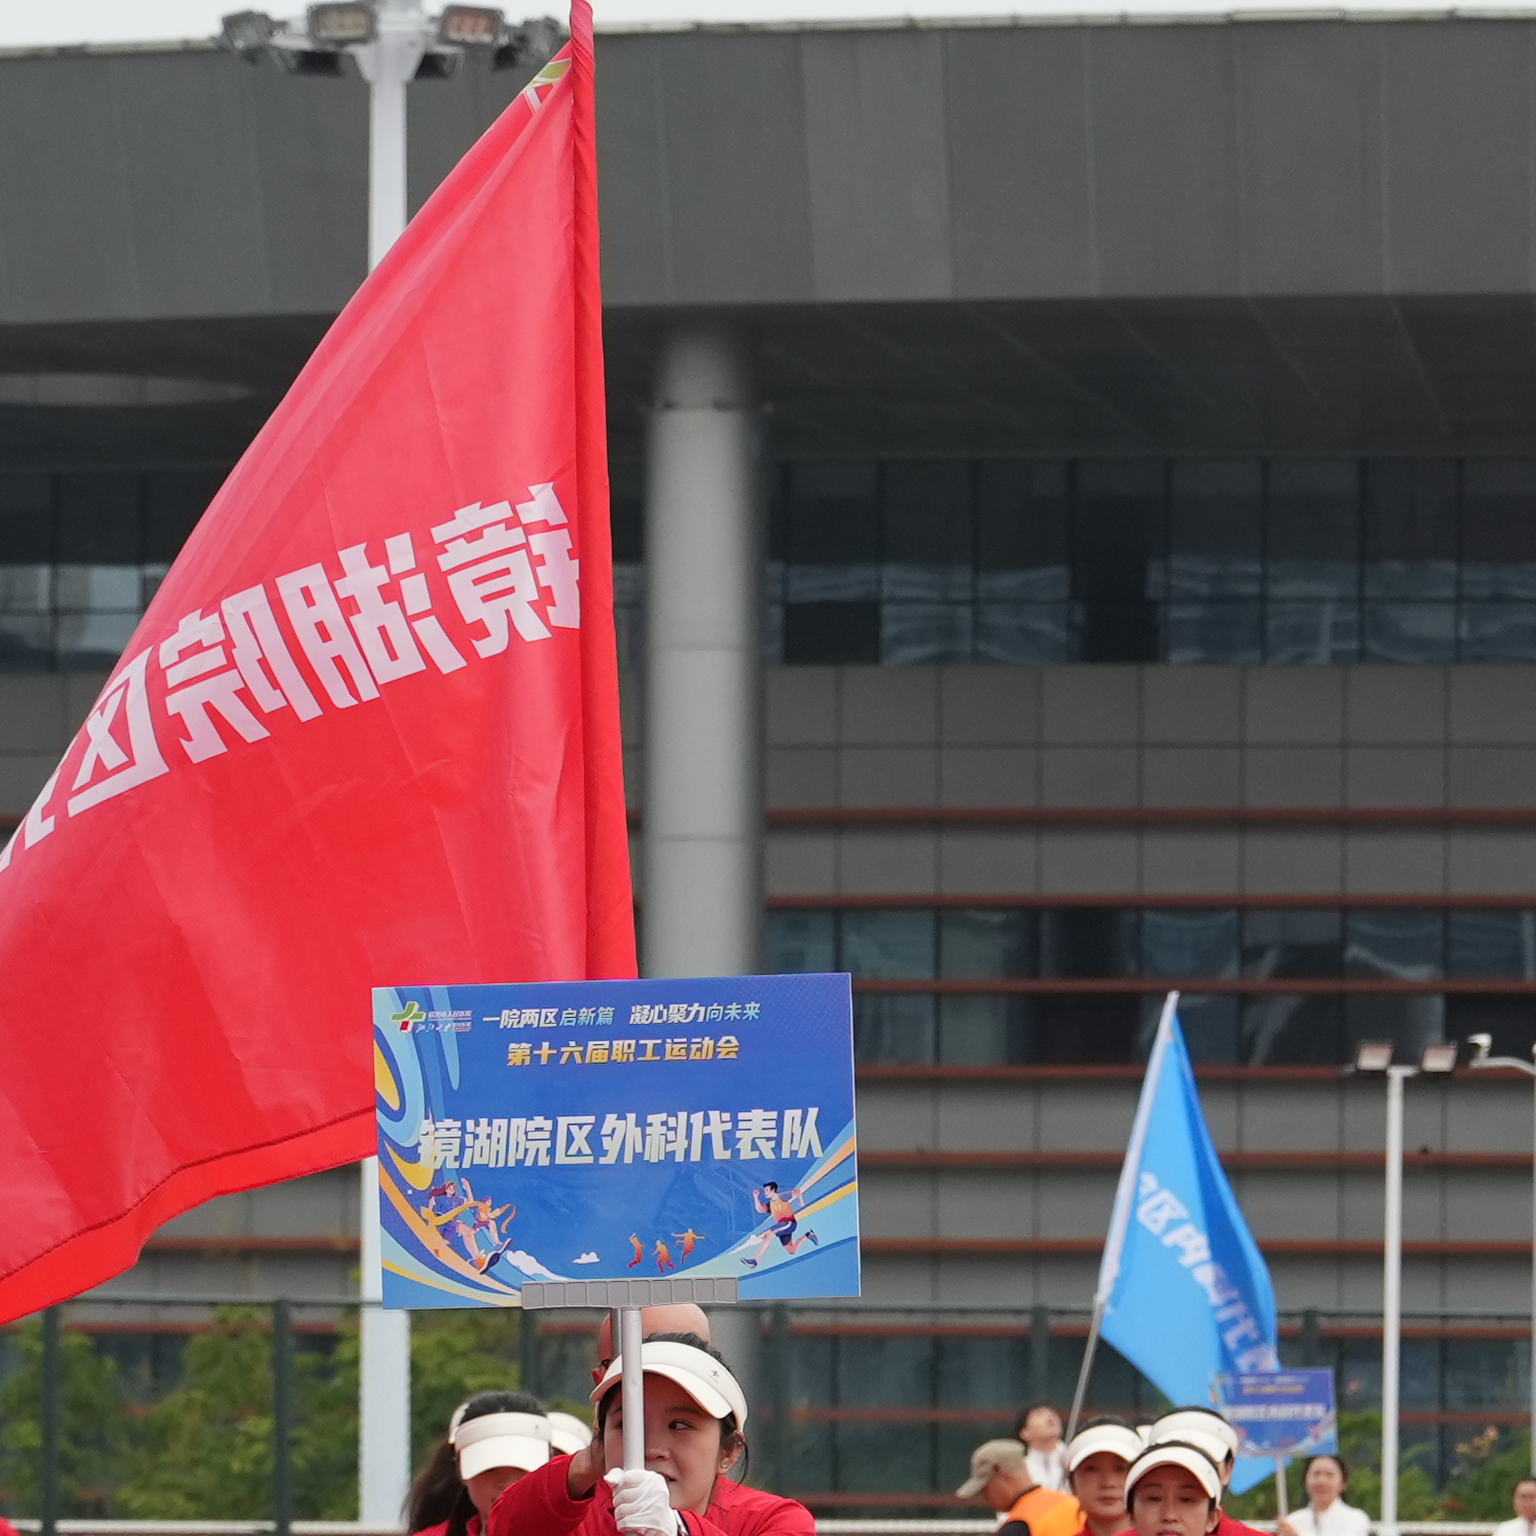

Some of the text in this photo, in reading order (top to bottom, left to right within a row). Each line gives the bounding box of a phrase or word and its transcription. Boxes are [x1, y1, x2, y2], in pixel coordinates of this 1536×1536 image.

[482, 1006, 615, 1029] 一院两区启新篇
[629, 1001, 761, 1025] 凝心聚力向未来
[507, 1035, 740, 1067] 第十六届职工运动会
[417, 1107, 825, 1170] 镜湖院区外科代表队
